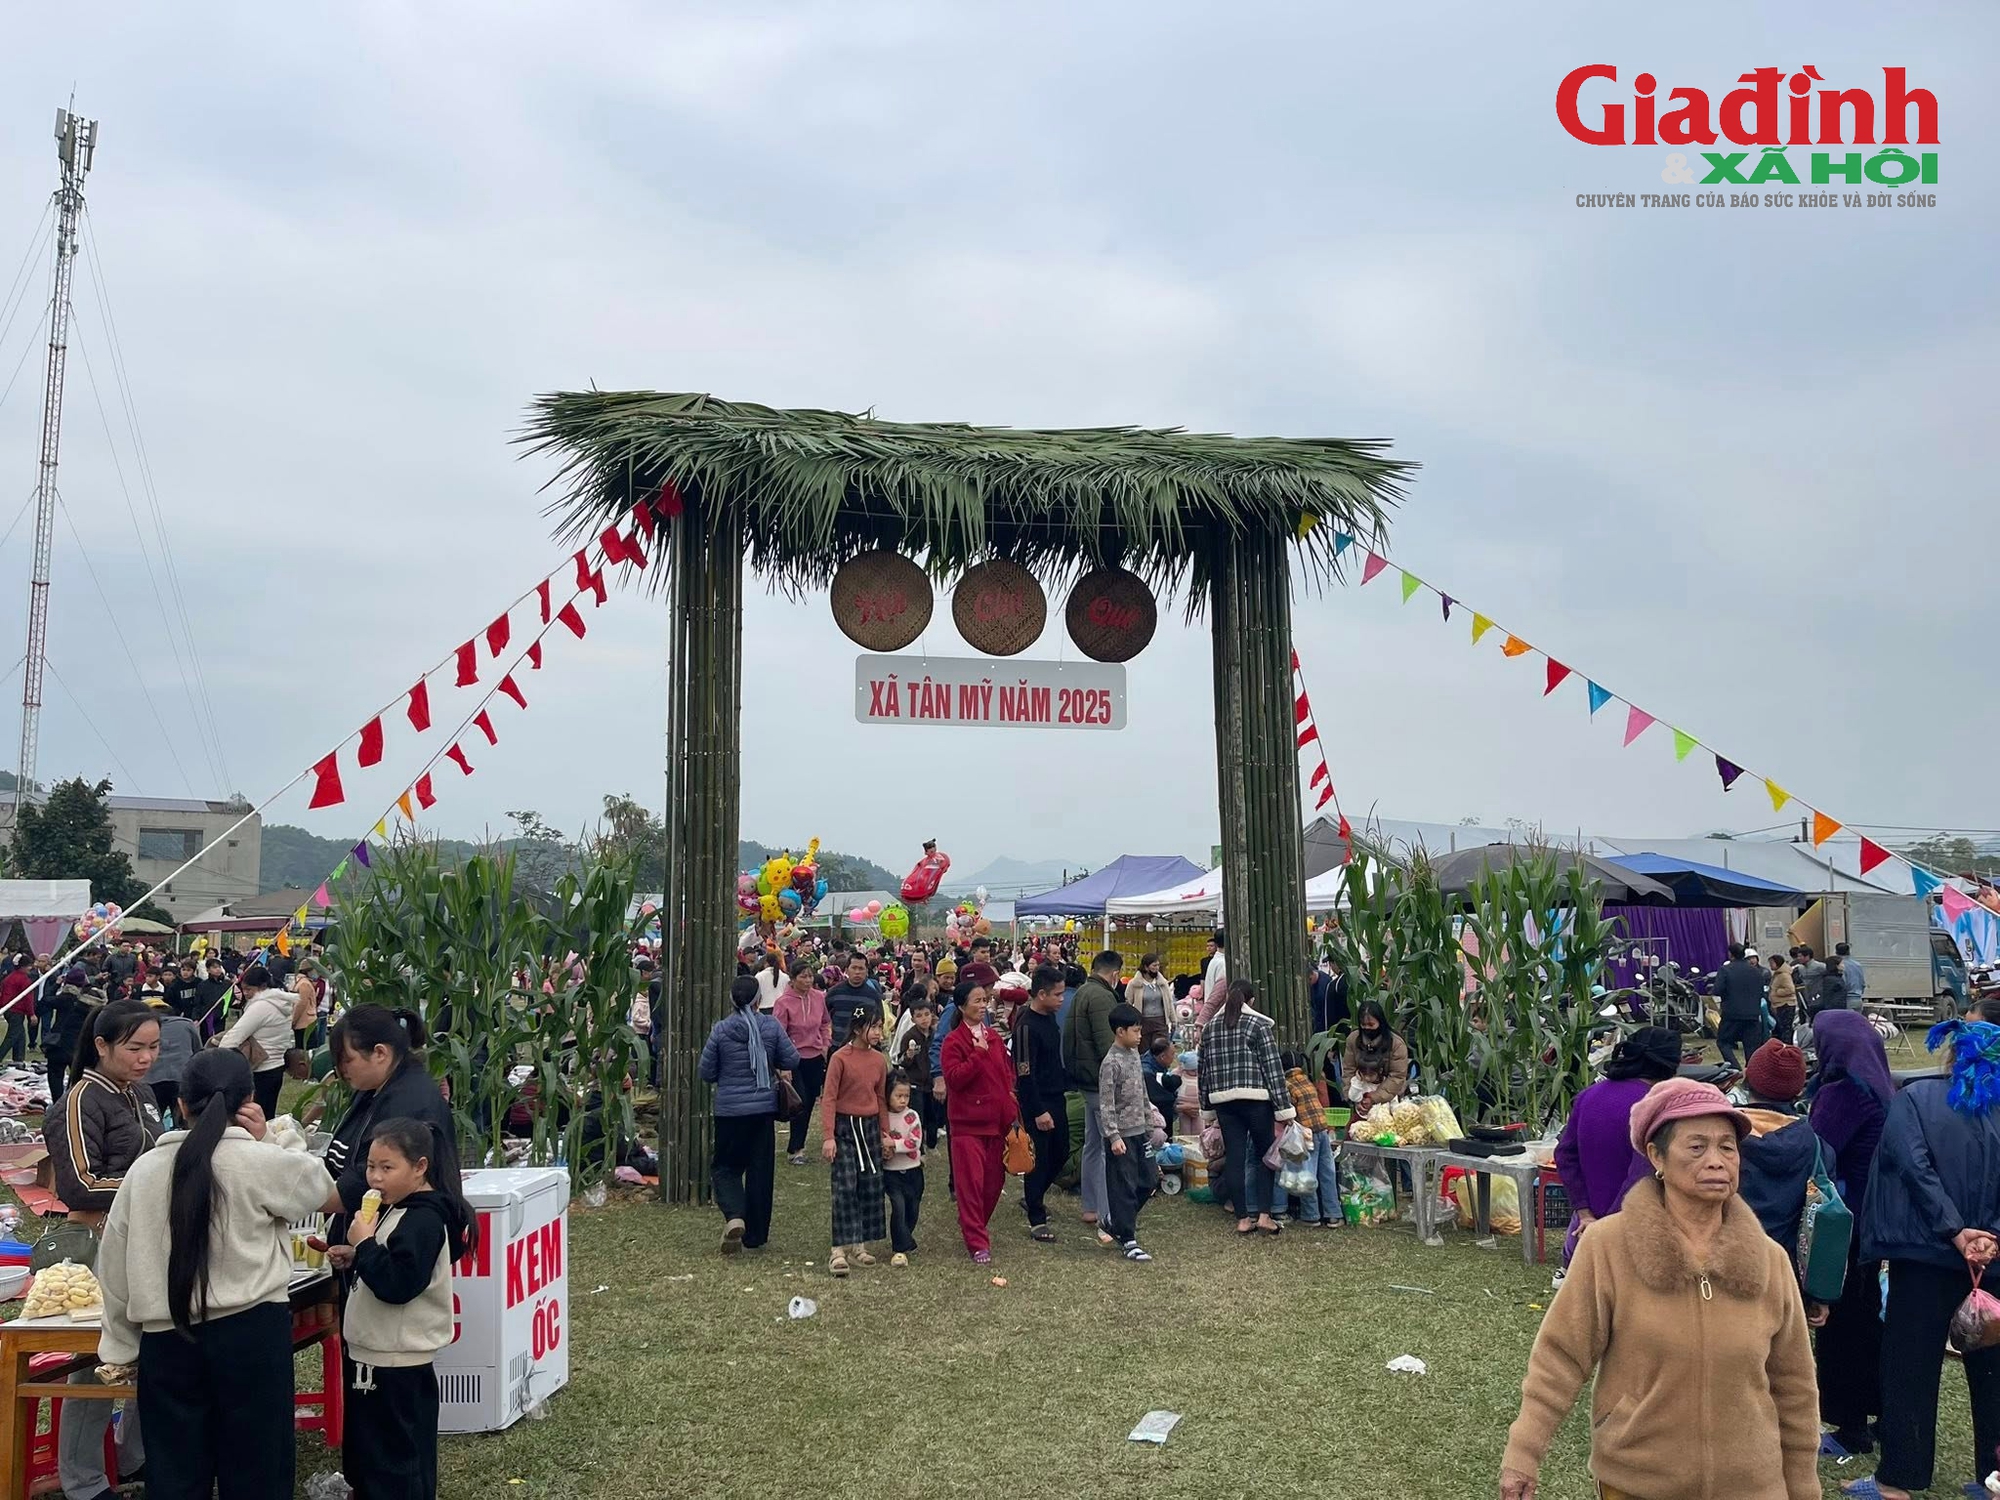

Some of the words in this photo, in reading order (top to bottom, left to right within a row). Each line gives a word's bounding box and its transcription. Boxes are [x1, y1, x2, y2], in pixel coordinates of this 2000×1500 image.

[869, 674, 900, 717] XÃ
[907, 676, 951, 719] TÂN
[958, 678, 993, 721] MỸ
[999, 679, 1051, 723] NĂM
[1058, 689, 1111, 724] 2025
[506, 1217, 562, 1310] KEM
[532, 1296, 561, 1361] ỐC
